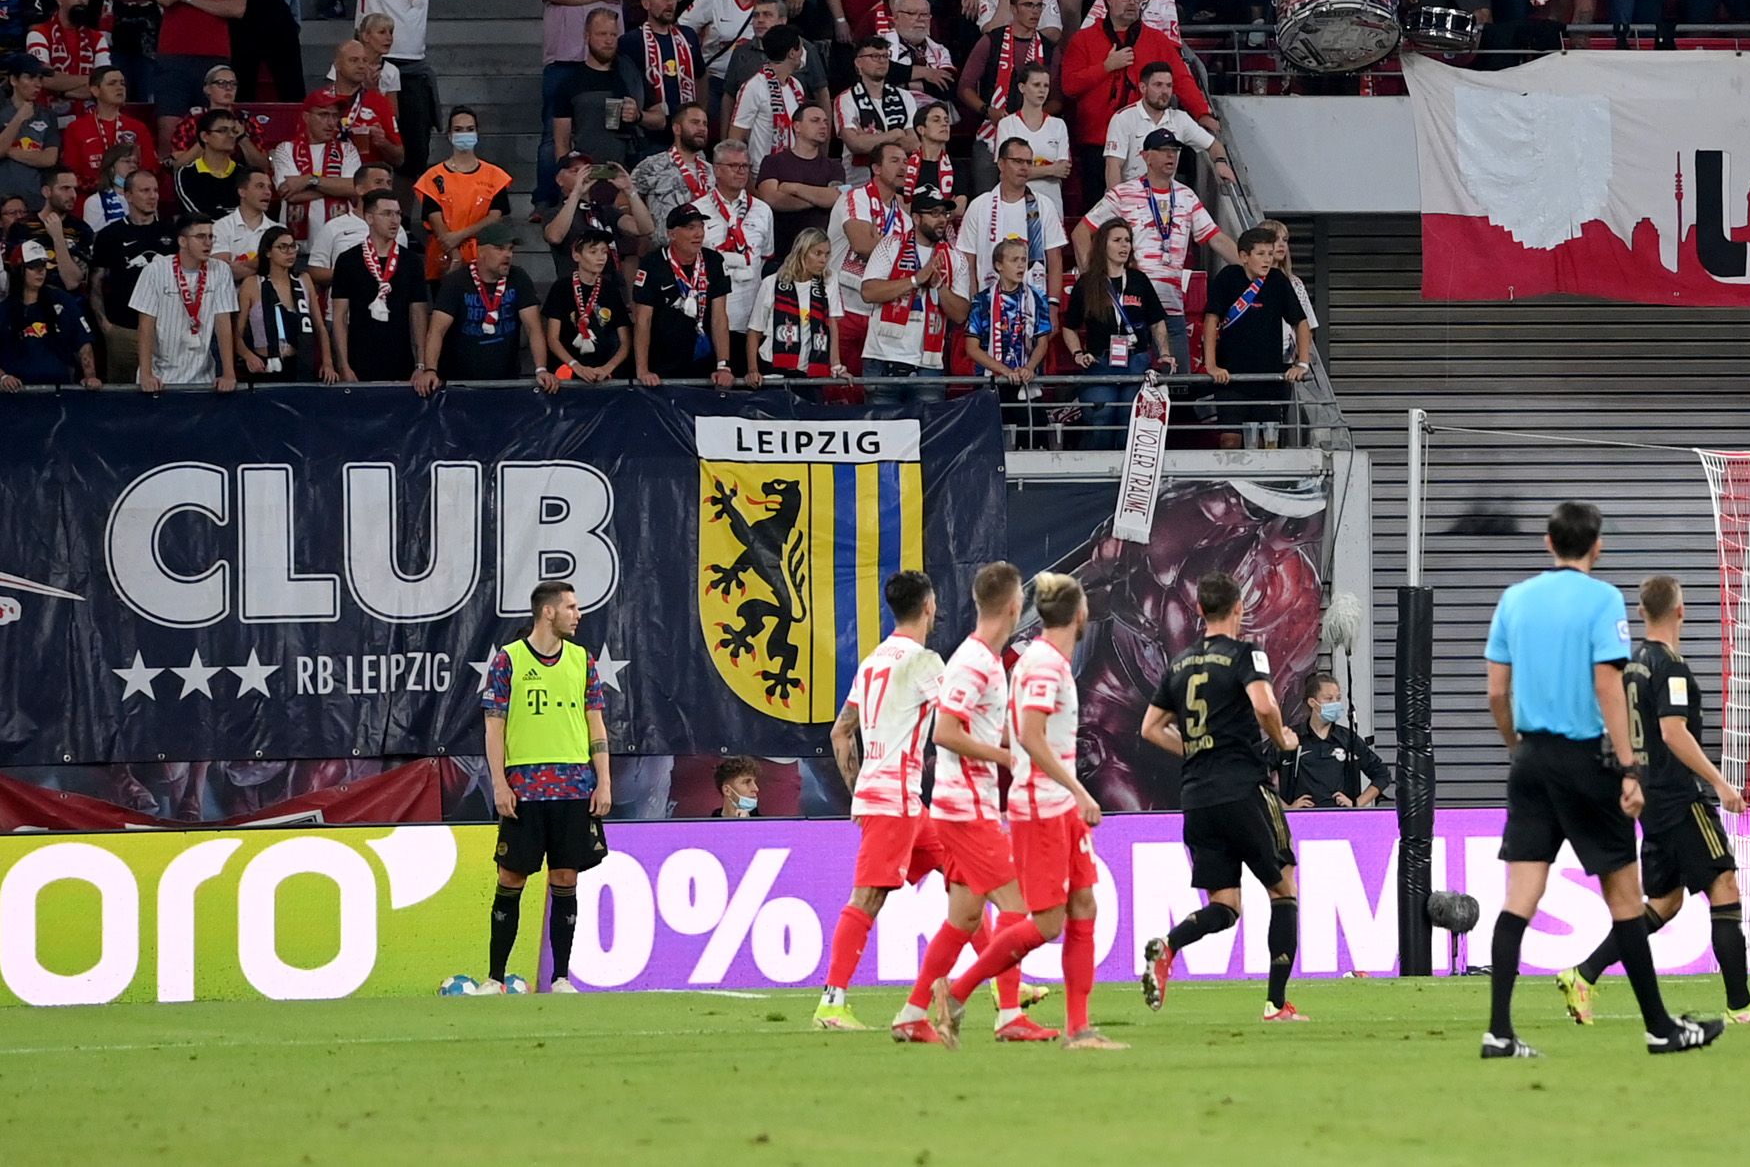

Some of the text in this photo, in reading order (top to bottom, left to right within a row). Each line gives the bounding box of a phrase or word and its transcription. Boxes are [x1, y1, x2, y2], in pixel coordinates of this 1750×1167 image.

[736, 426, 882, 456] LEIPZIG
[105, 461, 619, 629] CLUB
[296, 651, 452, 695] RB LEIPZIG
[863, 666, 892, 730] 17
[1186, 671, 1209, 739] 5
